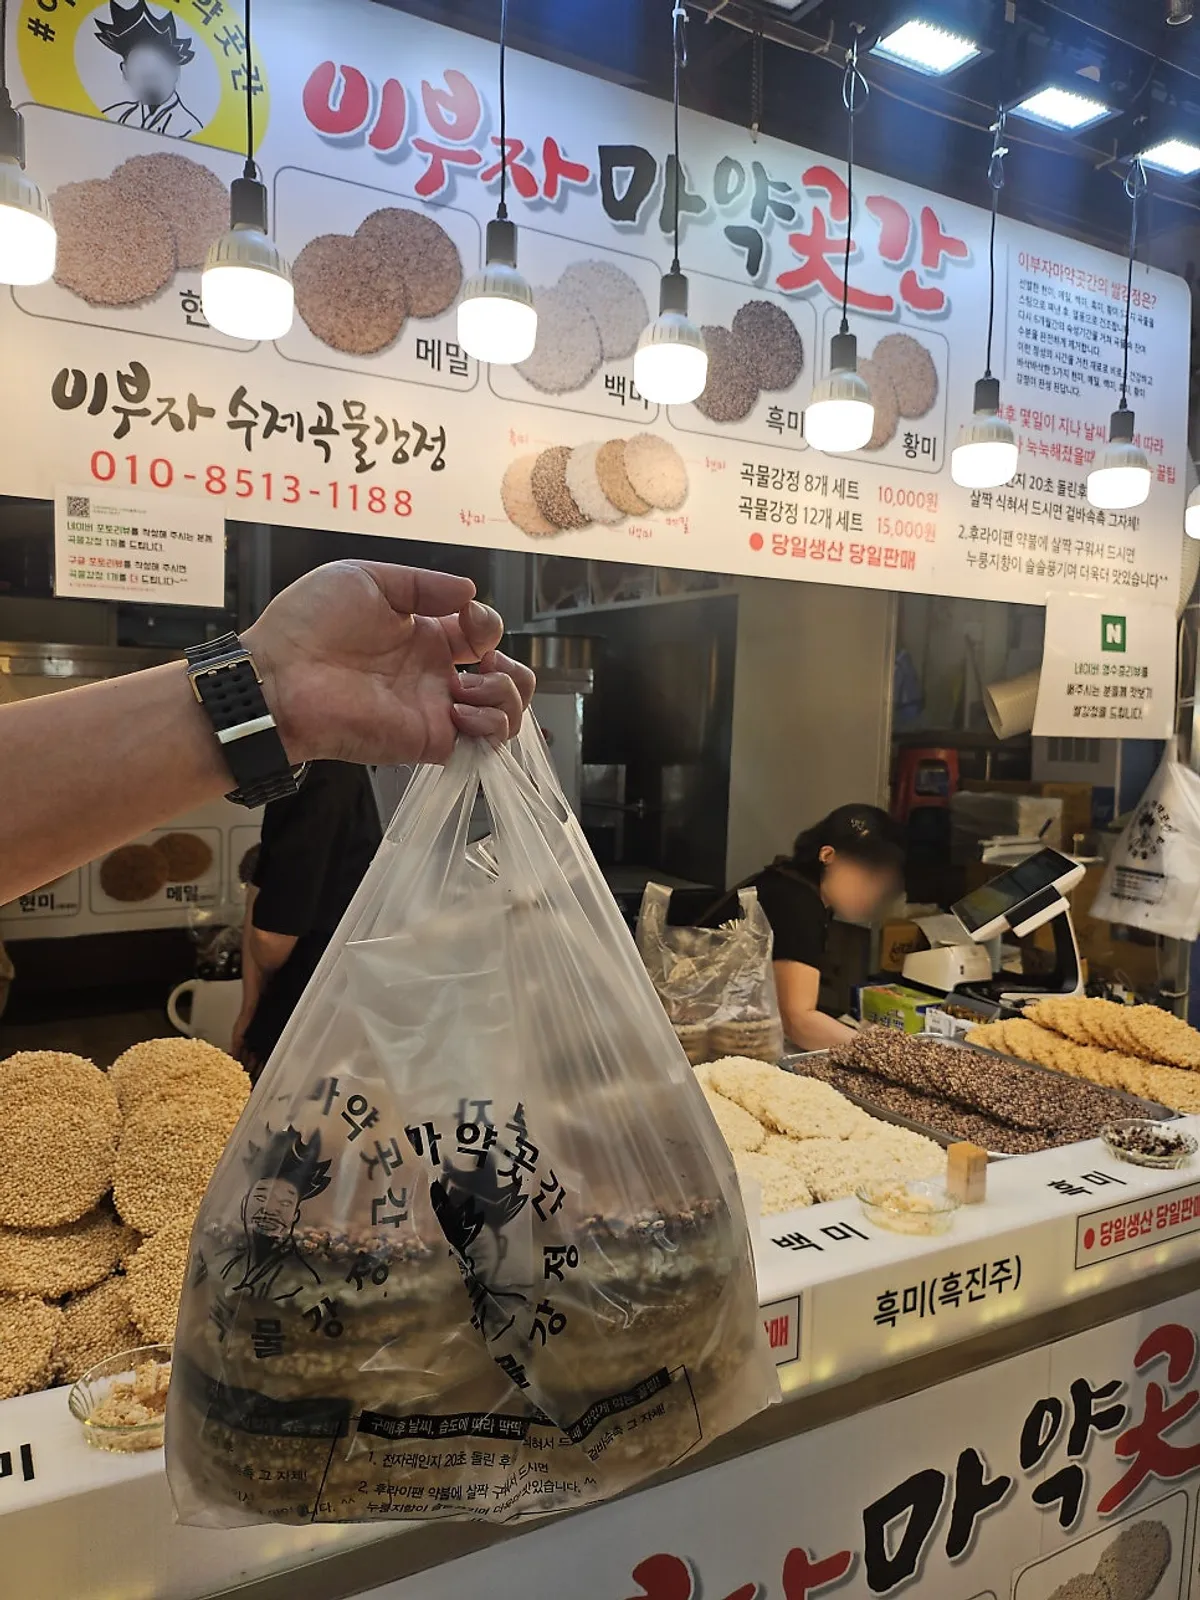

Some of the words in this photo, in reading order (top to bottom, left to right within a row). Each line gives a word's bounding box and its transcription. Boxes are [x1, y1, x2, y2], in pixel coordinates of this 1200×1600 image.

[415, 336, 470, 377] 메밀
[52, 362, 216, 440] 이부자
[226, 385, 447, 473] 수제곡물강정
[765, 405, 805, 439] 흑미
[1019, 408, 1056, 434] 몇일이
[1058, 416, 1082, 438] 지나
[1143, 436, 1165, 457] 따라
[902, 431, 937, 462] 황미
[90, 450, 413, 518] 010-8513-1188
[740, 462, 800, 493] 곡물강정
[804, 474, 828, 497] 8개
[832, 477, 860, 501] 세트
[878, 485, 939, 514] 10,000원
[1029, 475, 1054, 494] 20초
[1156, 463, 1176, 485] 꿀팁
[738, 495, 799, 526] 곡물강정
[803, 506, 832, 531] 12개
[835, 509, 864, 533] 세트
[876, 516, 937, 544] 15,000원
[970, 490, 993, 510] 살짝
[995, 494, 1028, 516] 식혀서
[1031, 500, 1063, 522] 드시면
[771, 533, 845, 563] 당일생산
[848, 542, 917, 572] 당일판매
[1016, 532, 1049, 552] 약불에
[1051, 536, 1072, 556] 살짝
[1074, 540, 1104, 559] 구워서
[1106, 544, 1136, 564] 드시면
[966, 551, 1023, 574] 누룽지향이
[1079, 566, 1110, 585] 더욱더
[1099, 1208, 1154, 1248] 당일생산
[872, 1254, 1023, 1328] 흑미(흑진주)
[382, 1452, 442, 1470] 전자레인지
[470, 1452, 496, 1468] 돌린
[498, 1454, 512, 1470] 후
[465, 1483, 490, 1500] 살짝
